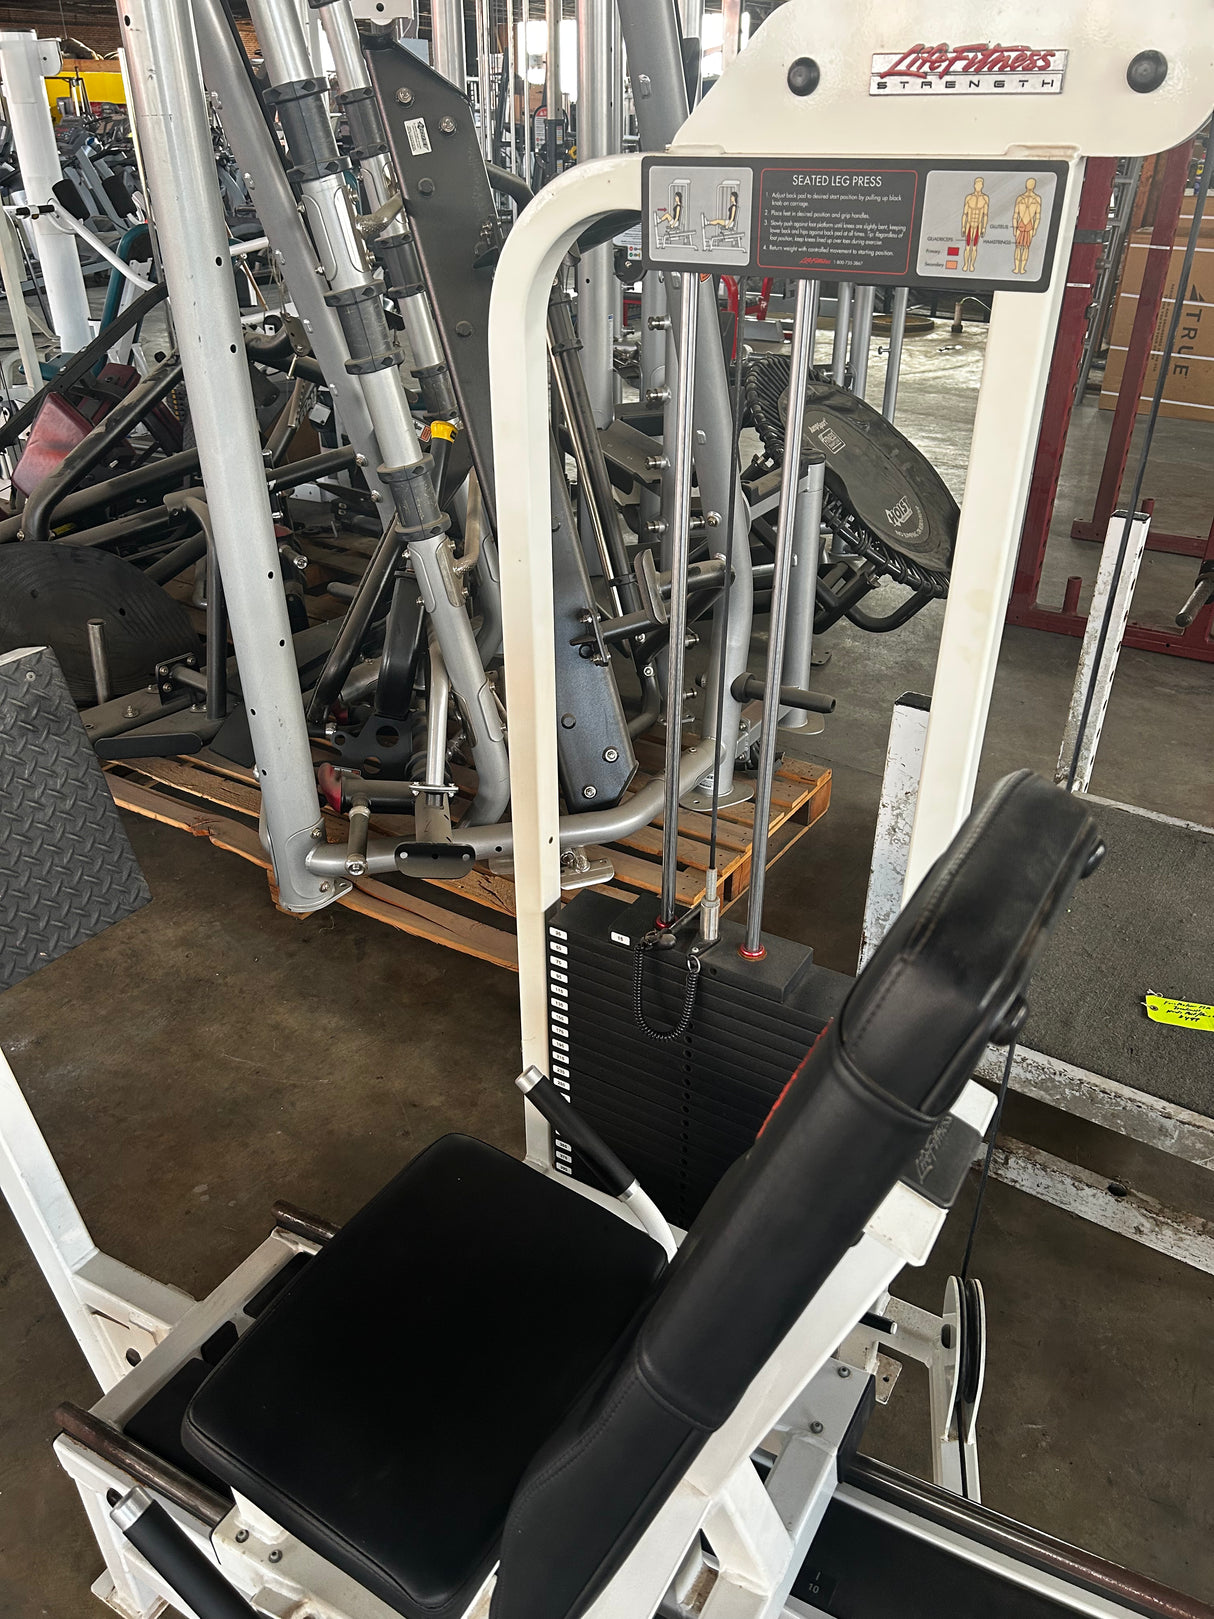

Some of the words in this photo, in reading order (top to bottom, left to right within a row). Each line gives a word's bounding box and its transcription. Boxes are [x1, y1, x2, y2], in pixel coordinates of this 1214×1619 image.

[876, 79, 1054, 90] STRENGTH
[792, 175, 829, 186] SEATED
[832, 175, 850, 187] LEG
[852, 176, 882, 187] PRESS
[1173, 309, 1202, 376] TRUE
[888, 497, 911, 525] HOIST
[808, 1583, 820, 1594] 10
